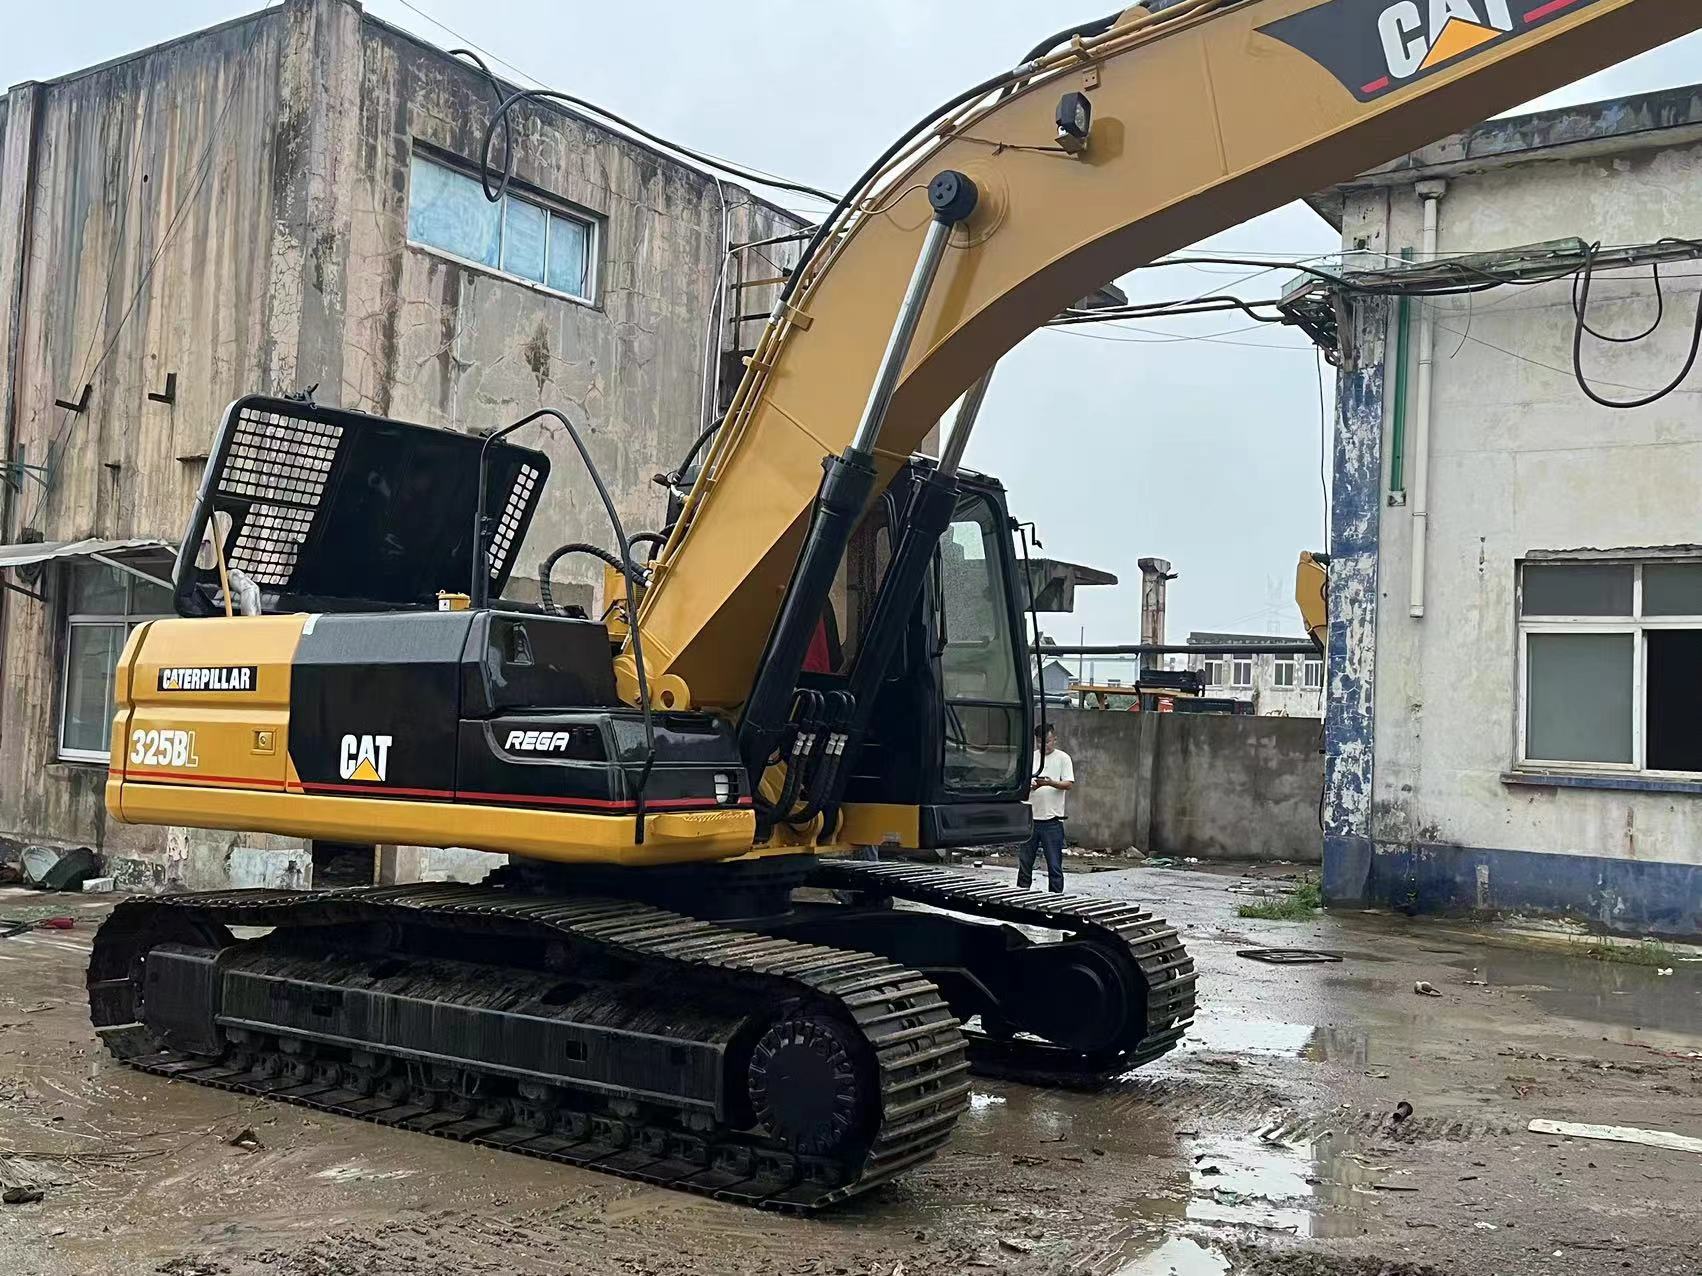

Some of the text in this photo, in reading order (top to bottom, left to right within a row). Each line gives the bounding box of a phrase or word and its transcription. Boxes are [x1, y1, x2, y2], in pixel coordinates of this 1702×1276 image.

[162, 667, 251, 690] CATERPILLAR
[504, 730, 570, 752] REGA
[339, 734, 393, 782] CAT
